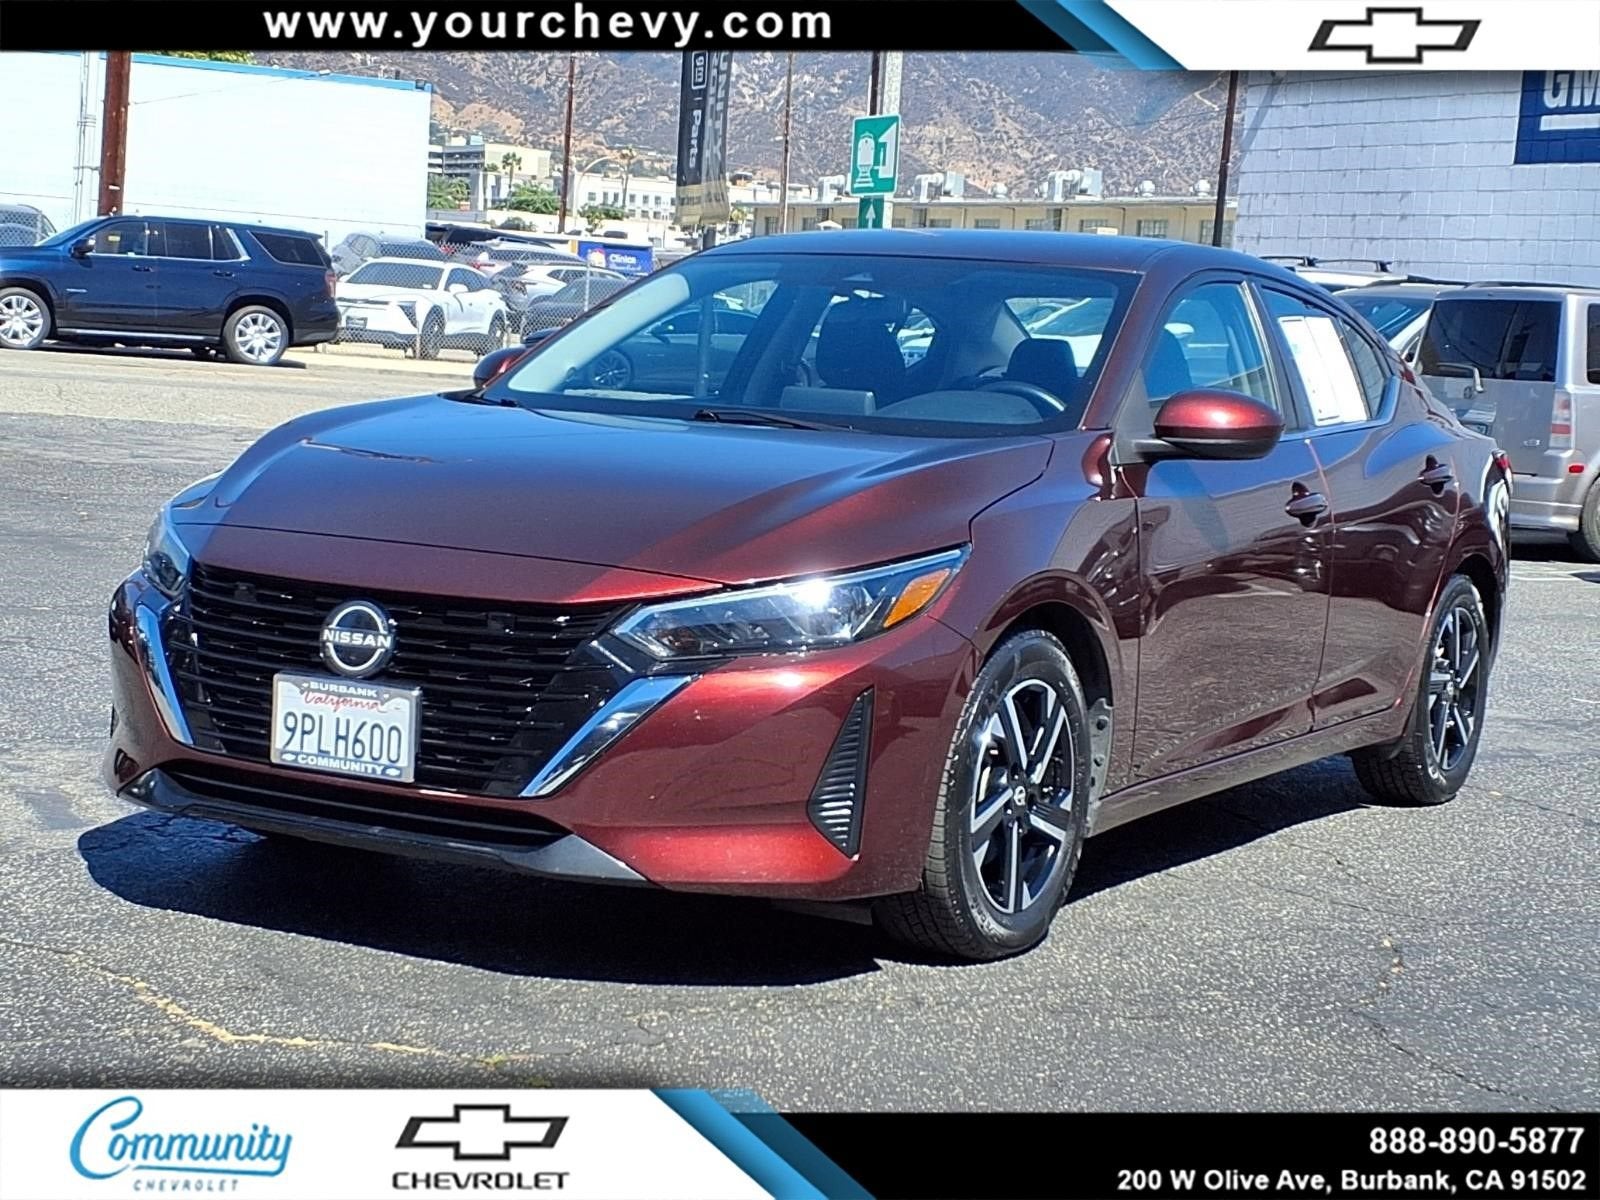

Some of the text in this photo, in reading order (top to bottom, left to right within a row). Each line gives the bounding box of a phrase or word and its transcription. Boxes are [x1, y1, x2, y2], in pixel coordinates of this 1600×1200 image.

[689, 109, 702, 168] Parts
[322, 628, 392, 649] NISSAN
[310, 681, 378, 697] BURBANK
[282, 711, 402, 764] 9PLH600
[297, 753, 385, 775] COMMUNITY
